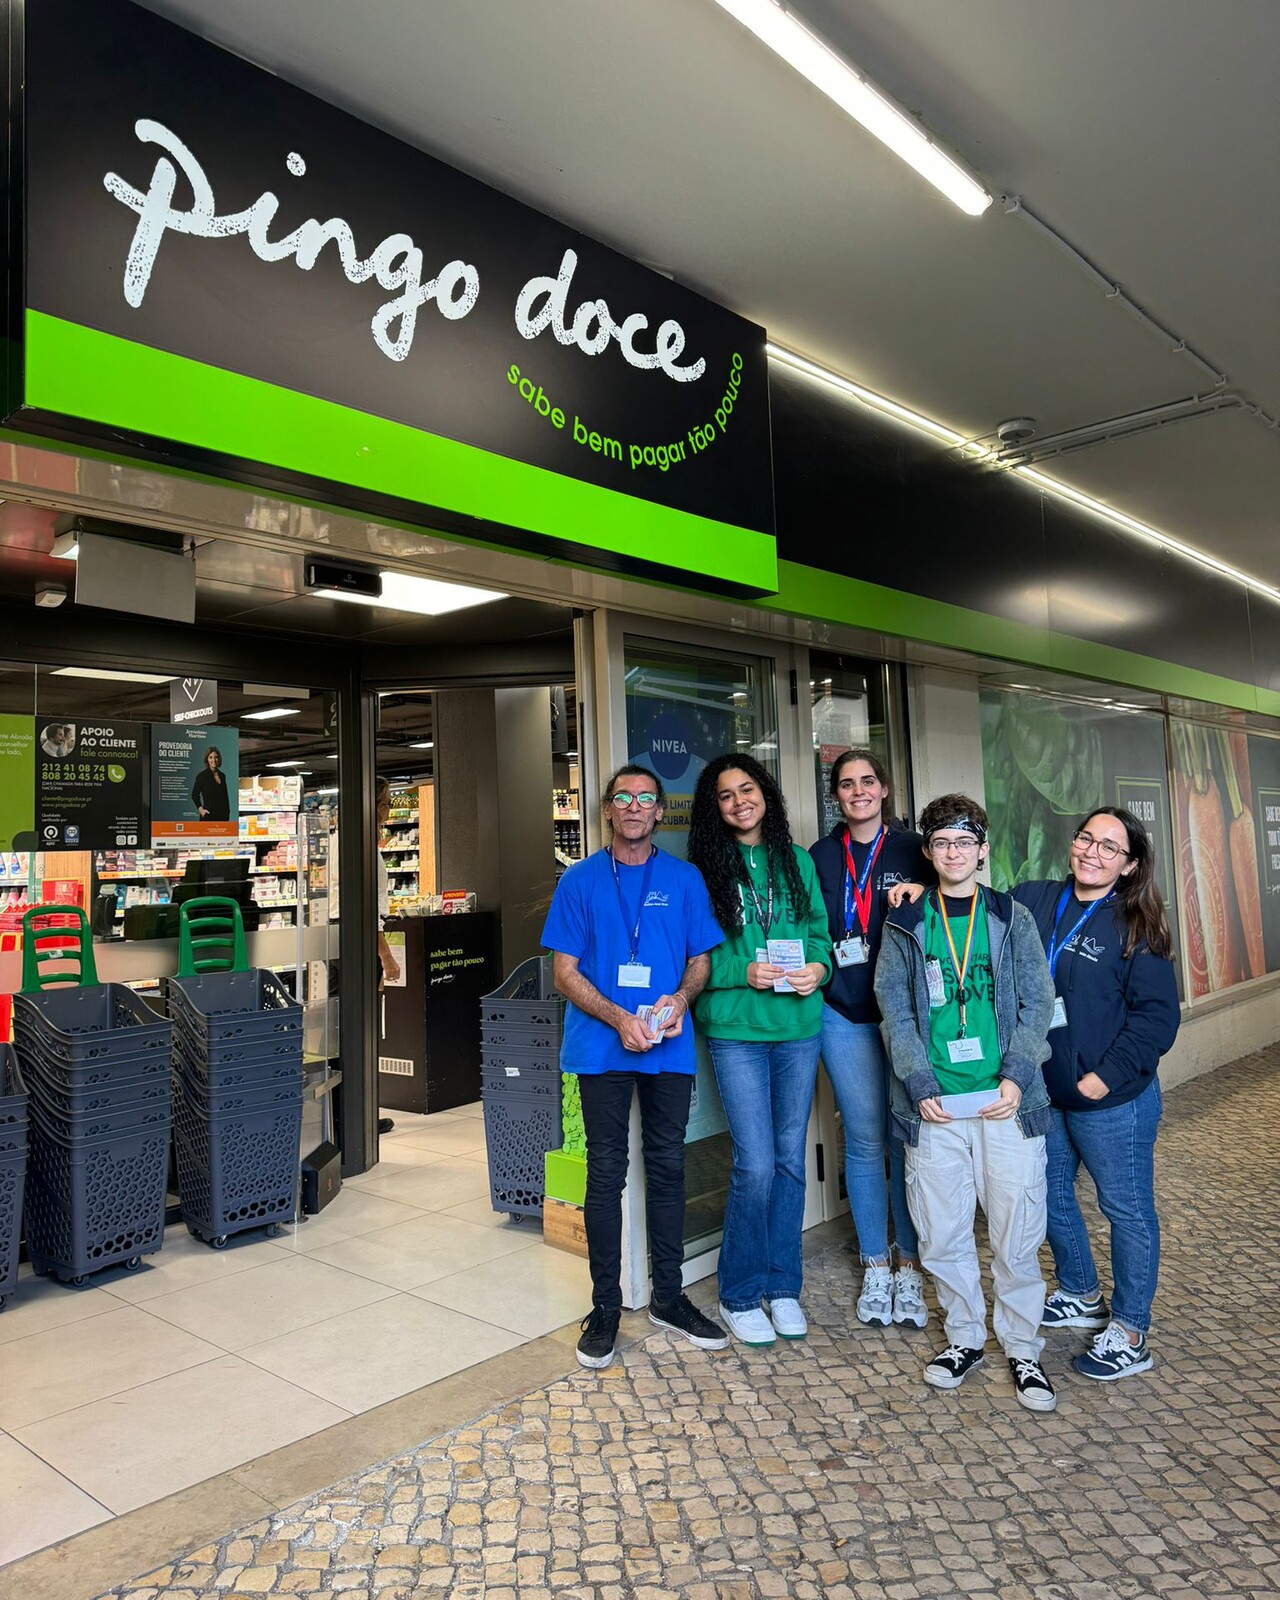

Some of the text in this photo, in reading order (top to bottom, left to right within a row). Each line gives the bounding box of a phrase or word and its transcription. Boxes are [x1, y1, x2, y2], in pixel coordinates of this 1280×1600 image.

[515, 249, 707, 383] doce
[506, 352, 744, 472] sabe bem pagar tão pouco
[174, 706, 214, 722] SELF-CHECKOUTS
[80, 726, 114, 737] APOIO
[80, 738, 137, 748] AO CLIENTE
[158, 741, 193, 750] PROVEDORIA
[652, 739, 688, 754] NIVEA
[80, 748, 139, 759] fale connosco!
[158, 749, 190, 758] DO CLIENTE
[41, 763, 105, 773] 212 41 08 74
[41, 772, 61, 780] 808
[63, 773, 76, 781] 20
[78, 773, 91, 781] 45
[1143, 801, 1156, 821] BEM
[430, 948, 463, 958] sabe bem
[430, 957, 485, 972] pagar tão pouco
